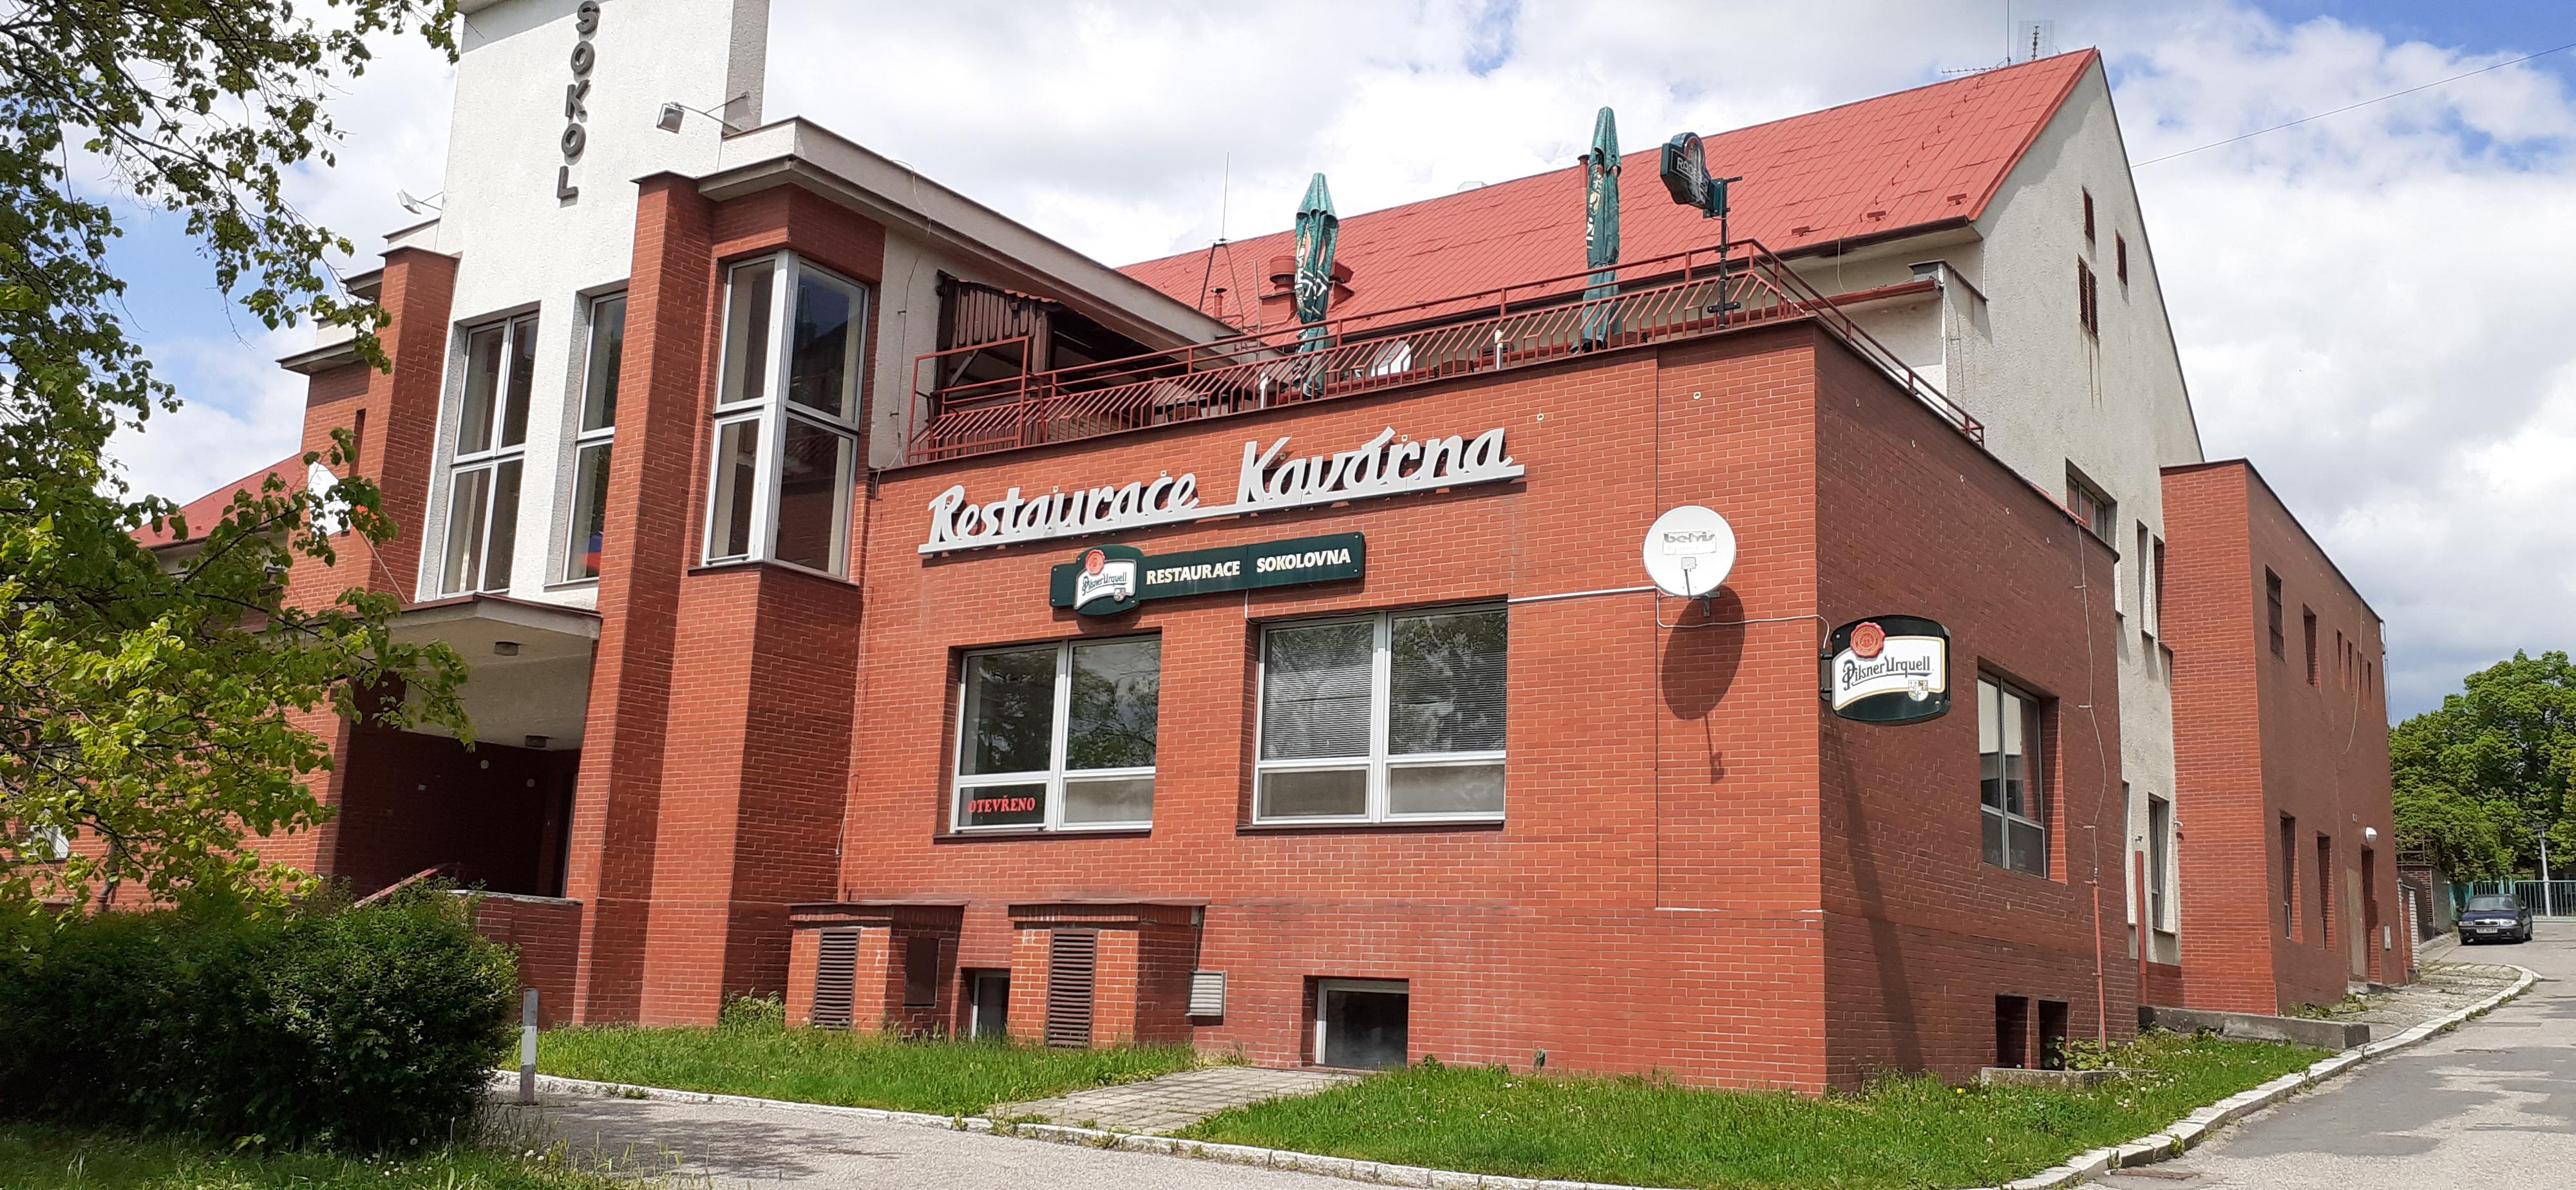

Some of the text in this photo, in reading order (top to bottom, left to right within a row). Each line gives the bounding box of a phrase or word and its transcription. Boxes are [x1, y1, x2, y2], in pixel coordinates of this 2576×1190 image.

[557, 1, 600, 199] SOKOL
[927, 426, 1513, 546] Restaurace Kavárna
[1082, 572, 1127, 596] Pilsner Urquell
[1146, 548, 1352, 585] RESTAURACE SOKOLOVNA
[1842, 656, 1930, 690] Pilsner Urquell
[968, 795, 1036, 813] OTEVŘENO
